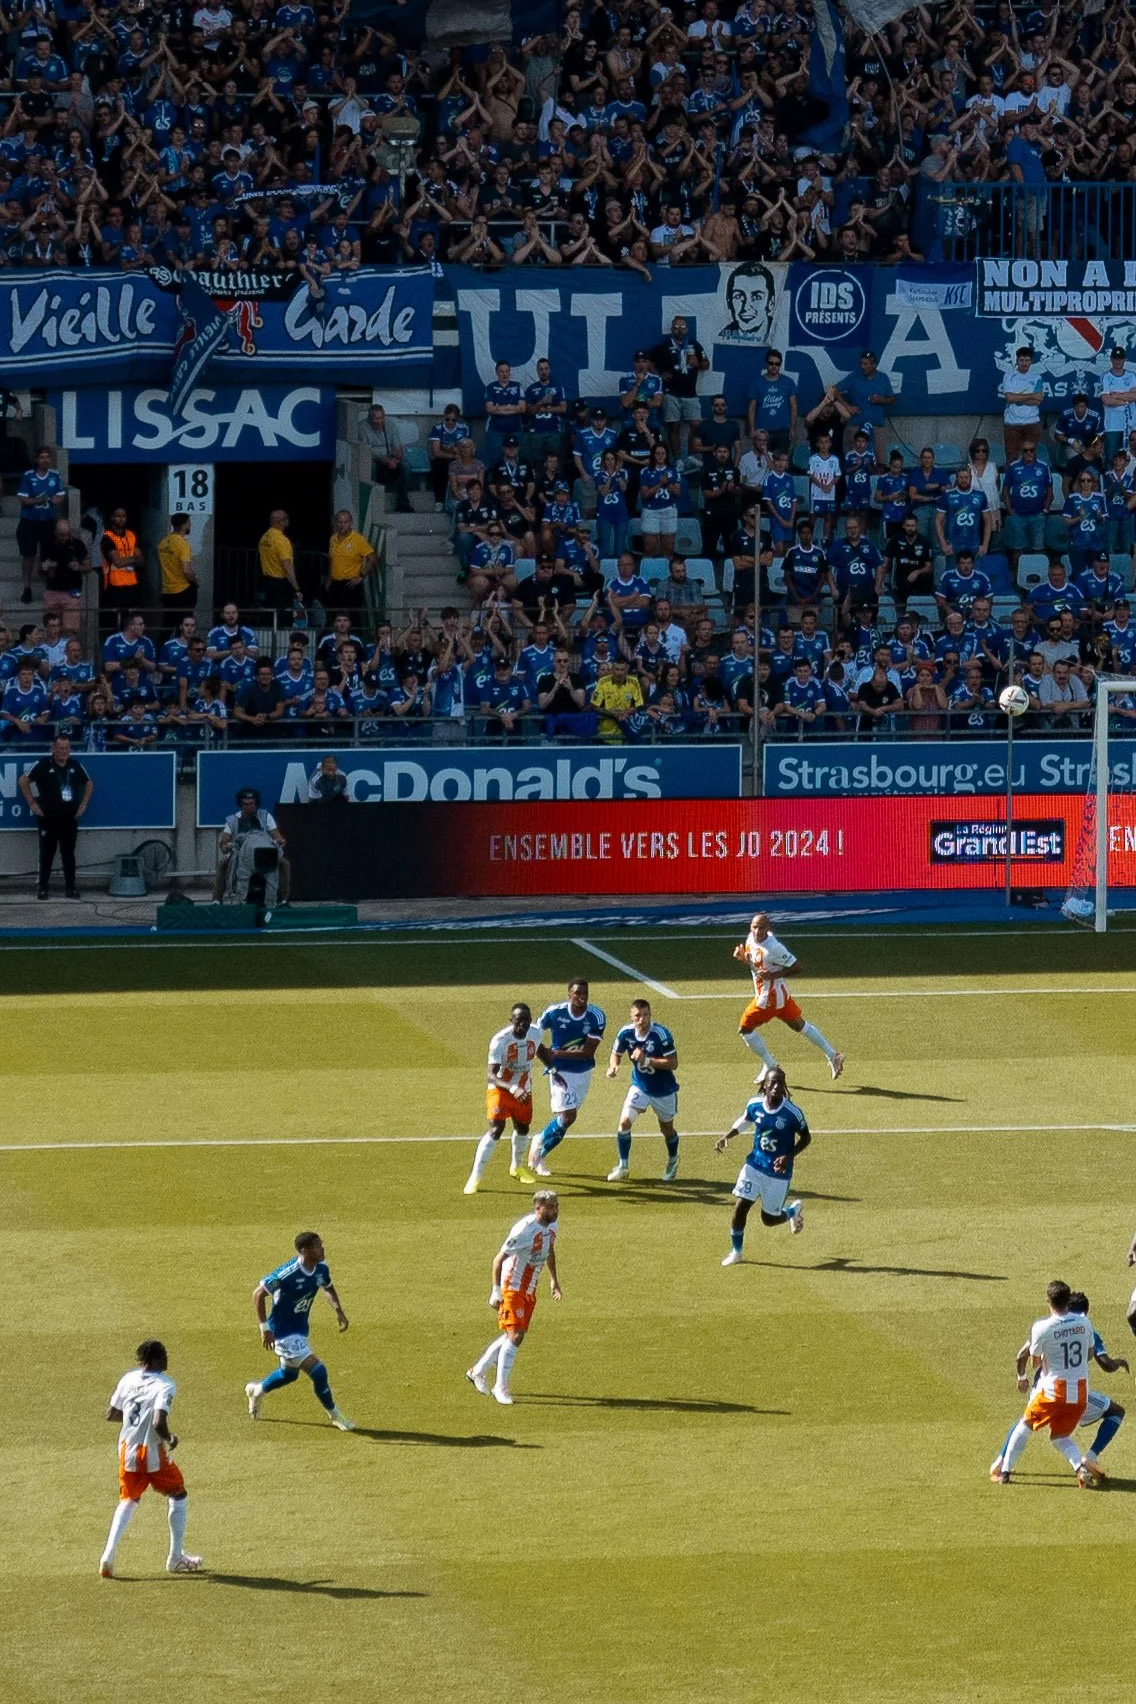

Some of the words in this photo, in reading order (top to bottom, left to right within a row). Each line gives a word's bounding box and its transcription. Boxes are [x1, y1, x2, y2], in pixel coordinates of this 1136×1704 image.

[983, 260, 1069, 288] NON
[1082, 260, 1110, 288] A
[810, 281, 854, 309] IDS
[9, 283, 157, 354] Vieille
[283, 283, 417, 349] Garde
[804, 310, 857, 325] PRÉSENTS
[62, 387, 322, 449] LISSAC
[173, 469, 209, 499] 18
[175, 501, 207, 511] BAS
[778, 754, 1025, 794] Strasbourg.eu
[489, 833, 611, 861] ENSEMBLE
[620, 830, 680, 860] VERS
[687, 830, 729, 859] LES
[736, 829, 761, 859] JO
[769, 829, 829, 858] 2024
[1060, 1340, 1083, 1370] 13
